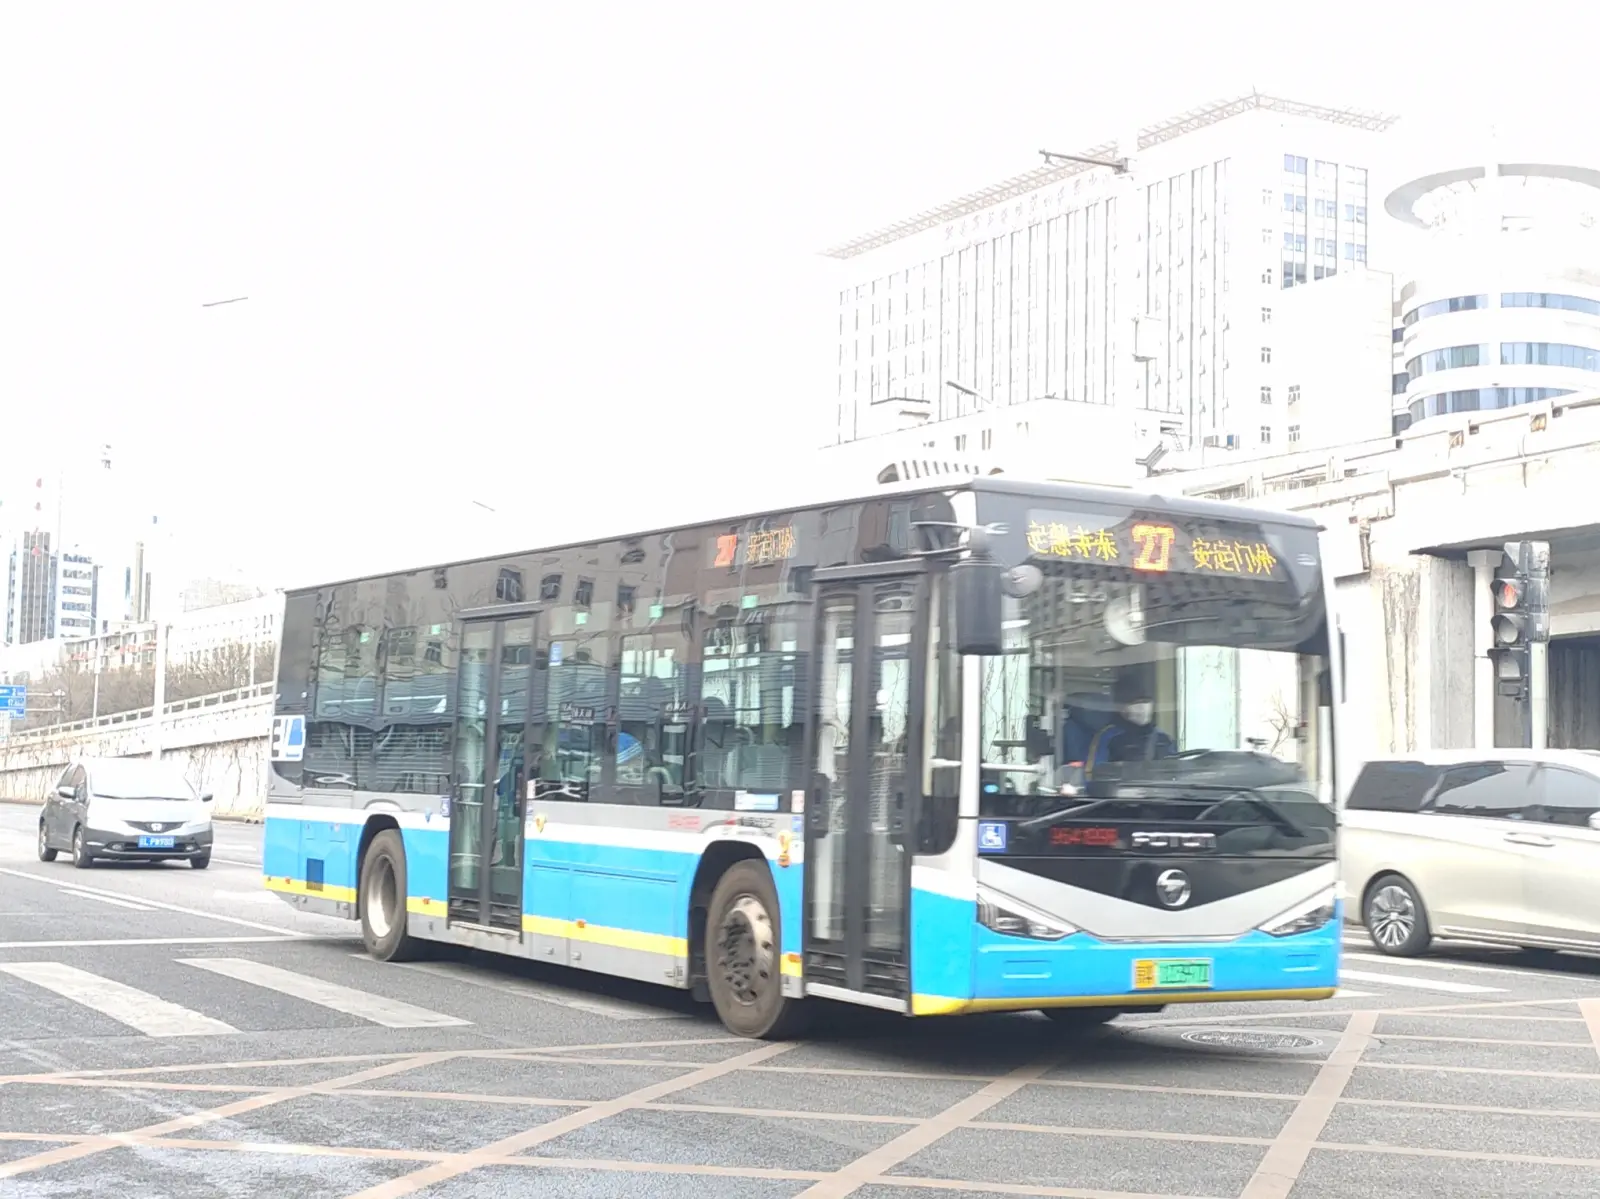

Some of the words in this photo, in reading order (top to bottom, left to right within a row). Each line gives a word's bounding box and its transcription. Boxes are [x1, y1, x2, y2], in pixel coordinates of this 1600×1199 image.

[1130, 522, 1175, 572] 27
[1189, 537, 1277, 576] 安定门外
